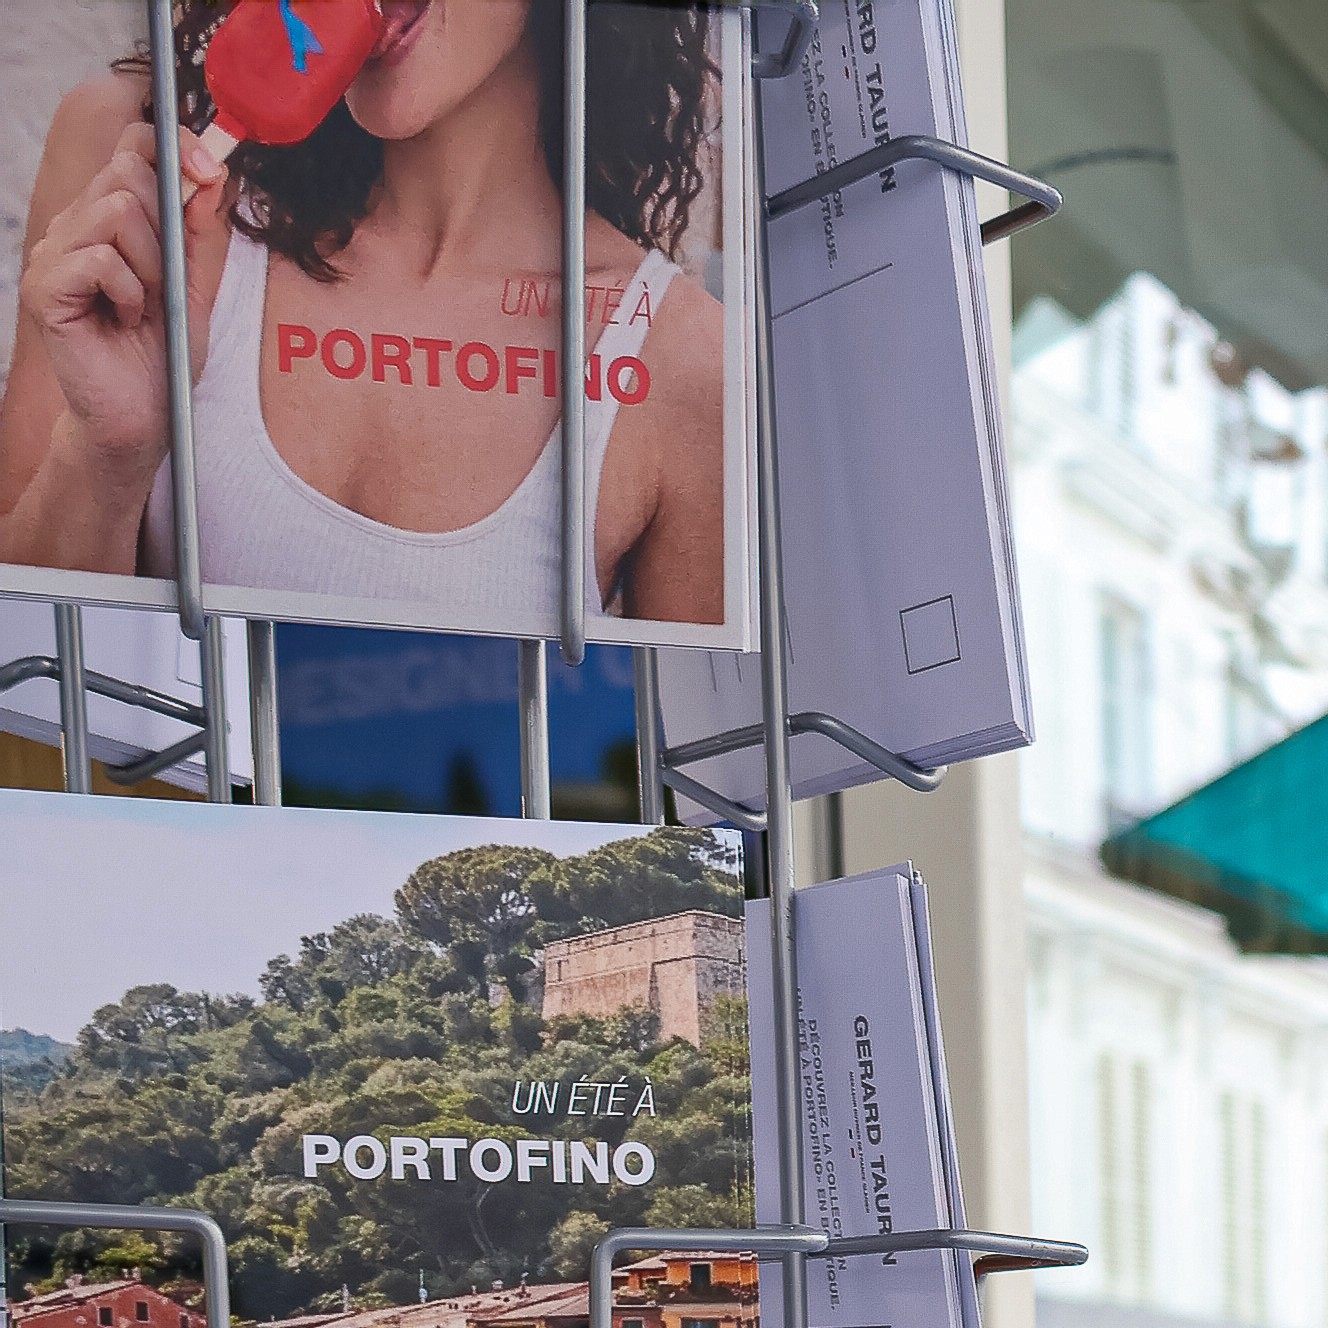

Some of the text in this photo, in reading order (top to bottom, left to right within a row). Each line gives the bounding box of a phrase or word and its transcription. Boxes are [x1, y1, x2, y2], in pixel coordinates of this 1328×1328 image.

[501, 278, 652, 328] UN TÉ À
[512, 1074, 658, 1117] UN ÉTÉ À
[302, 1133, 656, 1187] PORTOFINO
[854, 1015, 897, 1266] GERARD TAURN
